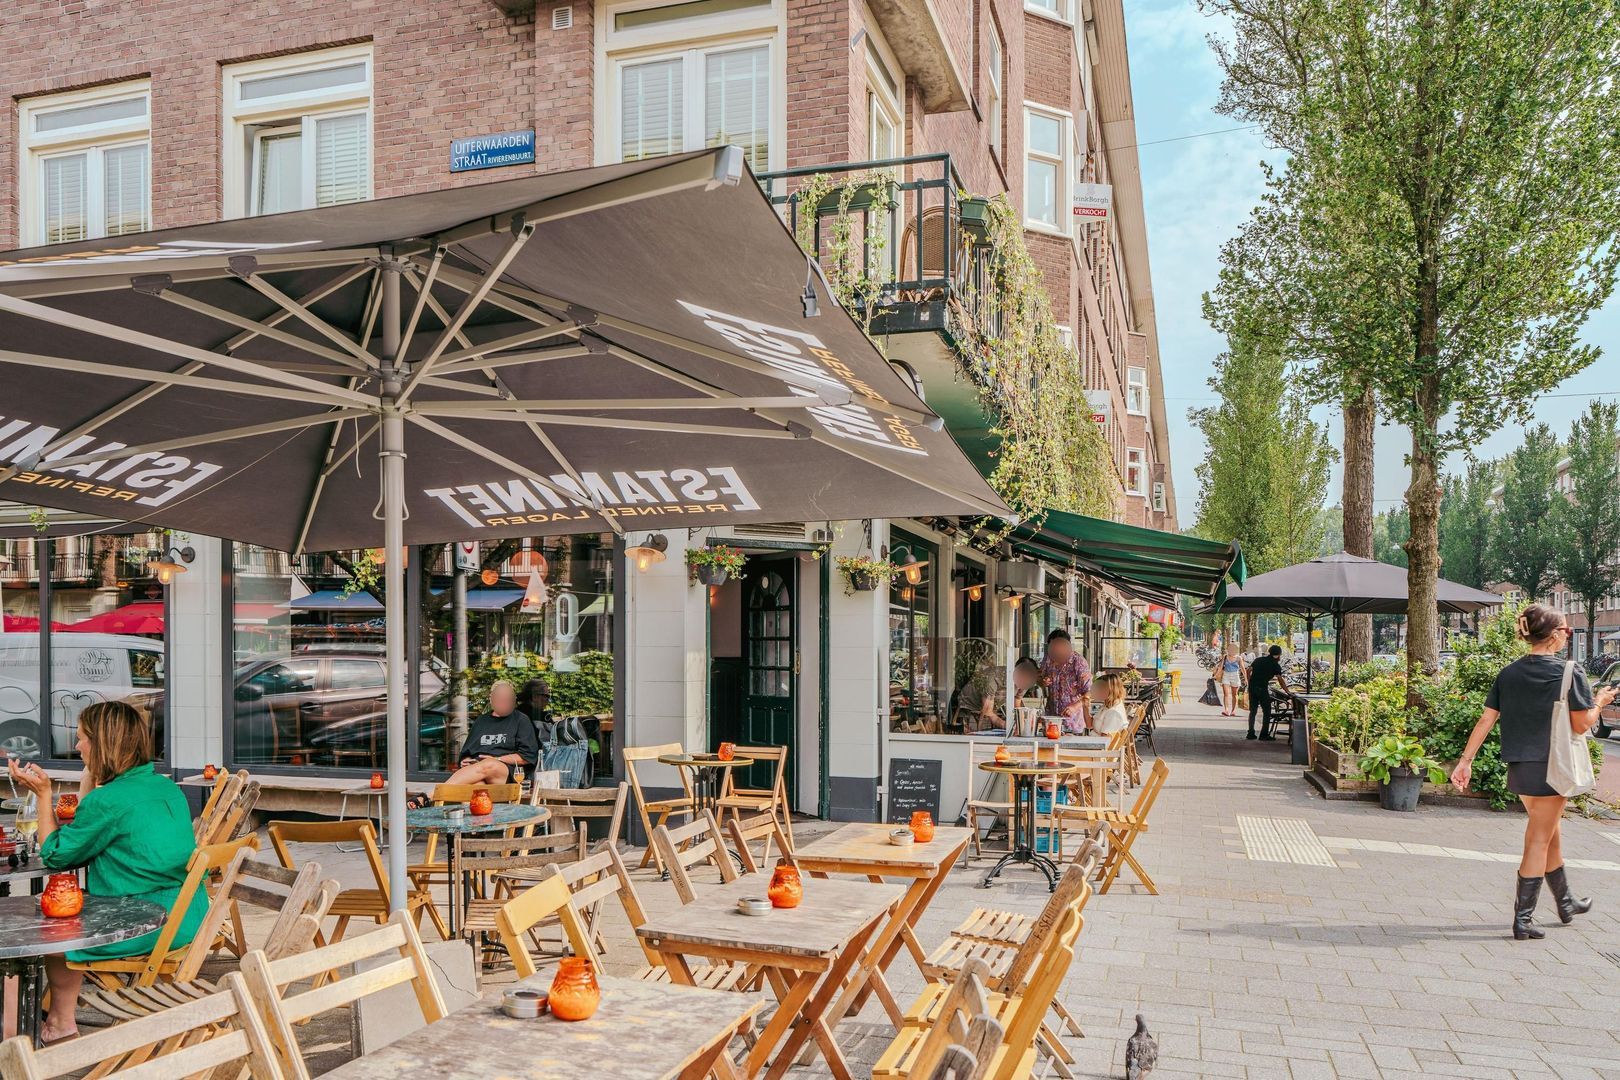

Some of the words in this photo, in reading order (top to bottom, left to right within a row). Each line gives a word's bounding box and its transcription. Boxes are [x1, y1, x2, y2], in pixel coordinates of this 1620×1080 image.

[455, 135, 529, 154] UITERWAARDEN
[454, 154, 487, 168] STRAAT
[488, 152, 531, 163] RIVIERENBUURT
[1074, 208, 1105, 216] VERKOCHT
